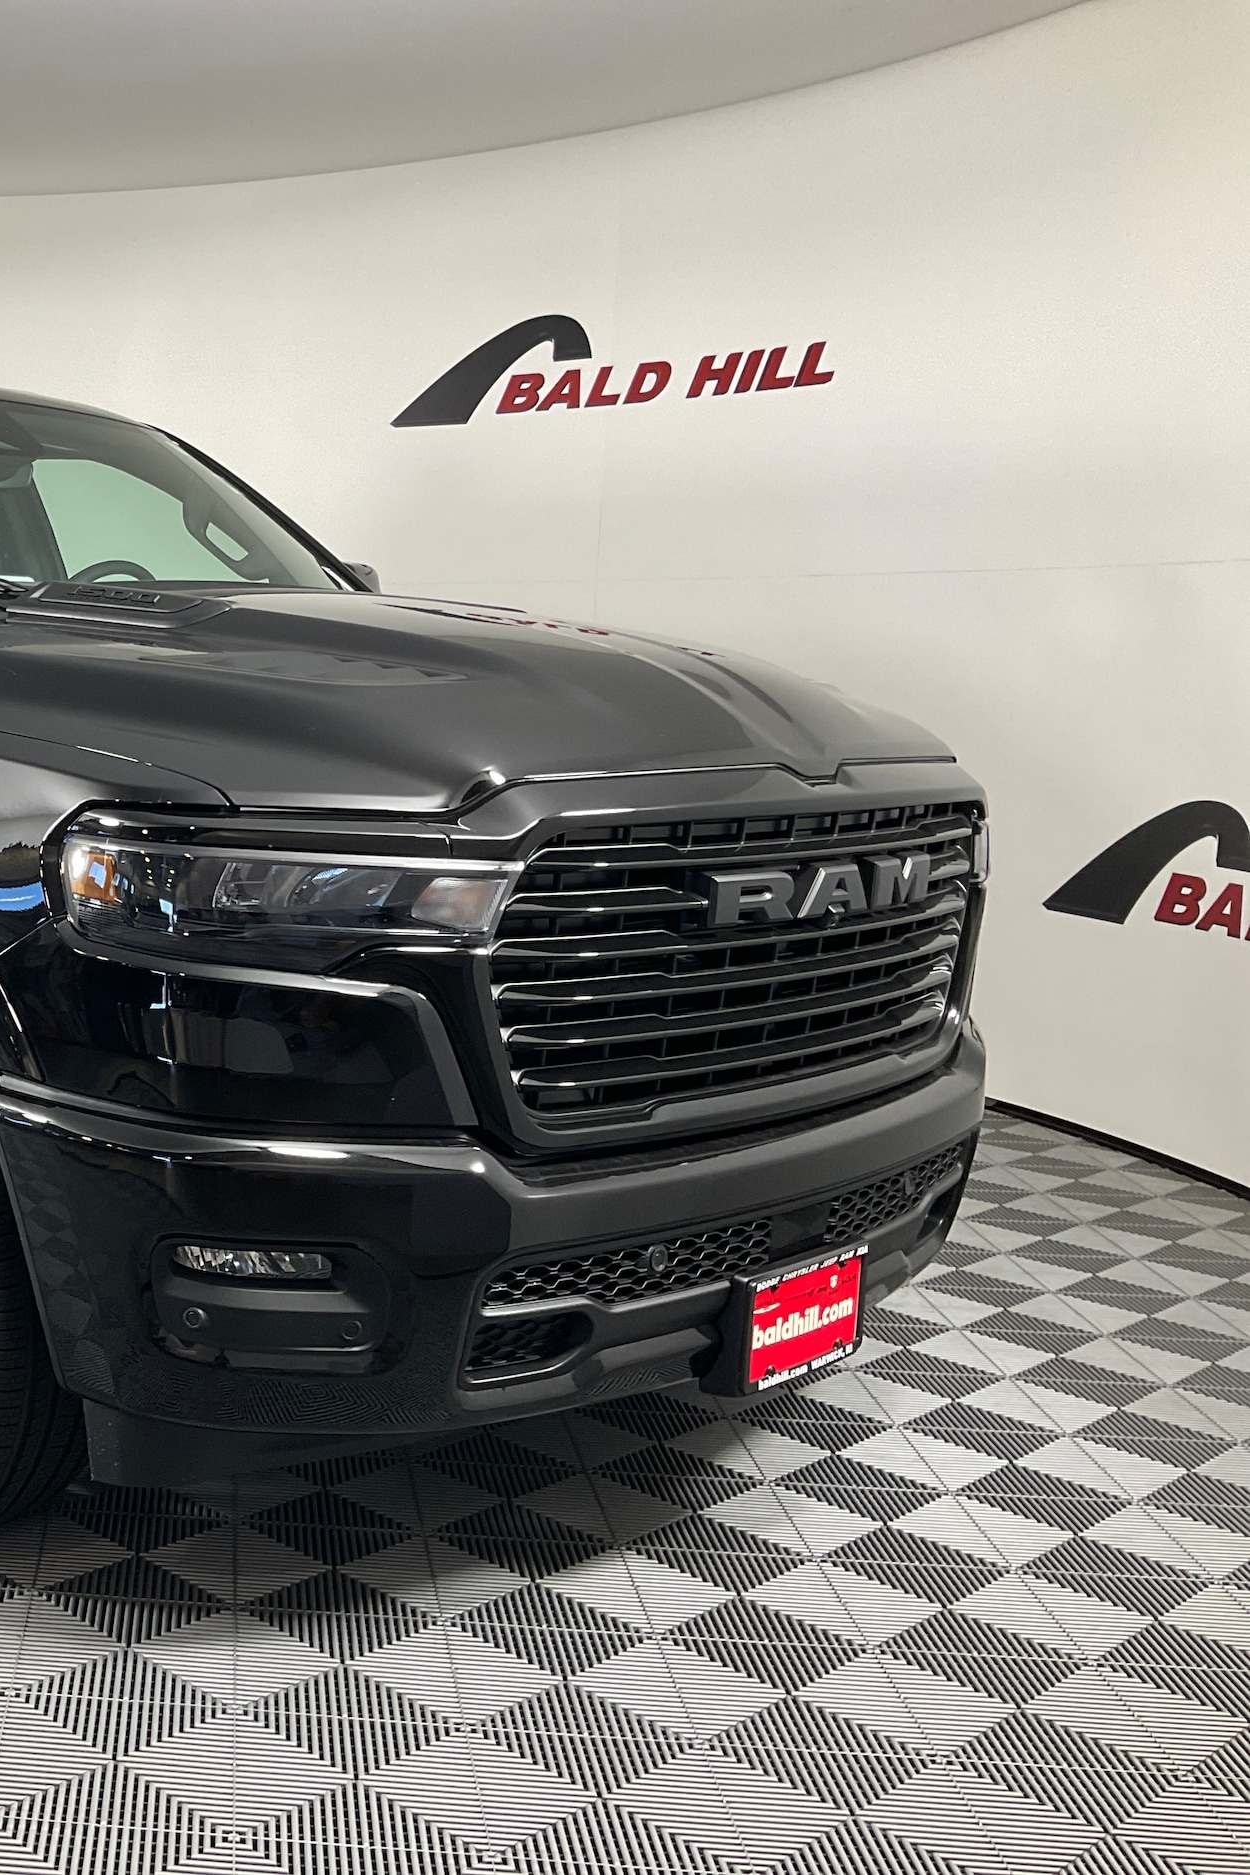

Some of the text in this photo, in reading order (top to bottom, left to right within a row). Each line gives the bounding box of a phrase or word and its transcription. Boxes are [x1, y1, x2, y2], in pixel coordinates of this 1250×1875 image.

[495, 341, 835, 414] BALD HILL
[708, 851, 931, 927] RAM
[1154, 872, 1250, 942] BA
[756, 1276, 781, 1293] DODGE
[782, 1263, 820, 1282] CHRYSLER
[839, 1250, 855, 1262] RAM
[856, 1244, 869, 1257] KIA
[752, 1297, 854, 1351] baldhill.com
[758, 1364, 808, 1391] baldhill.com
